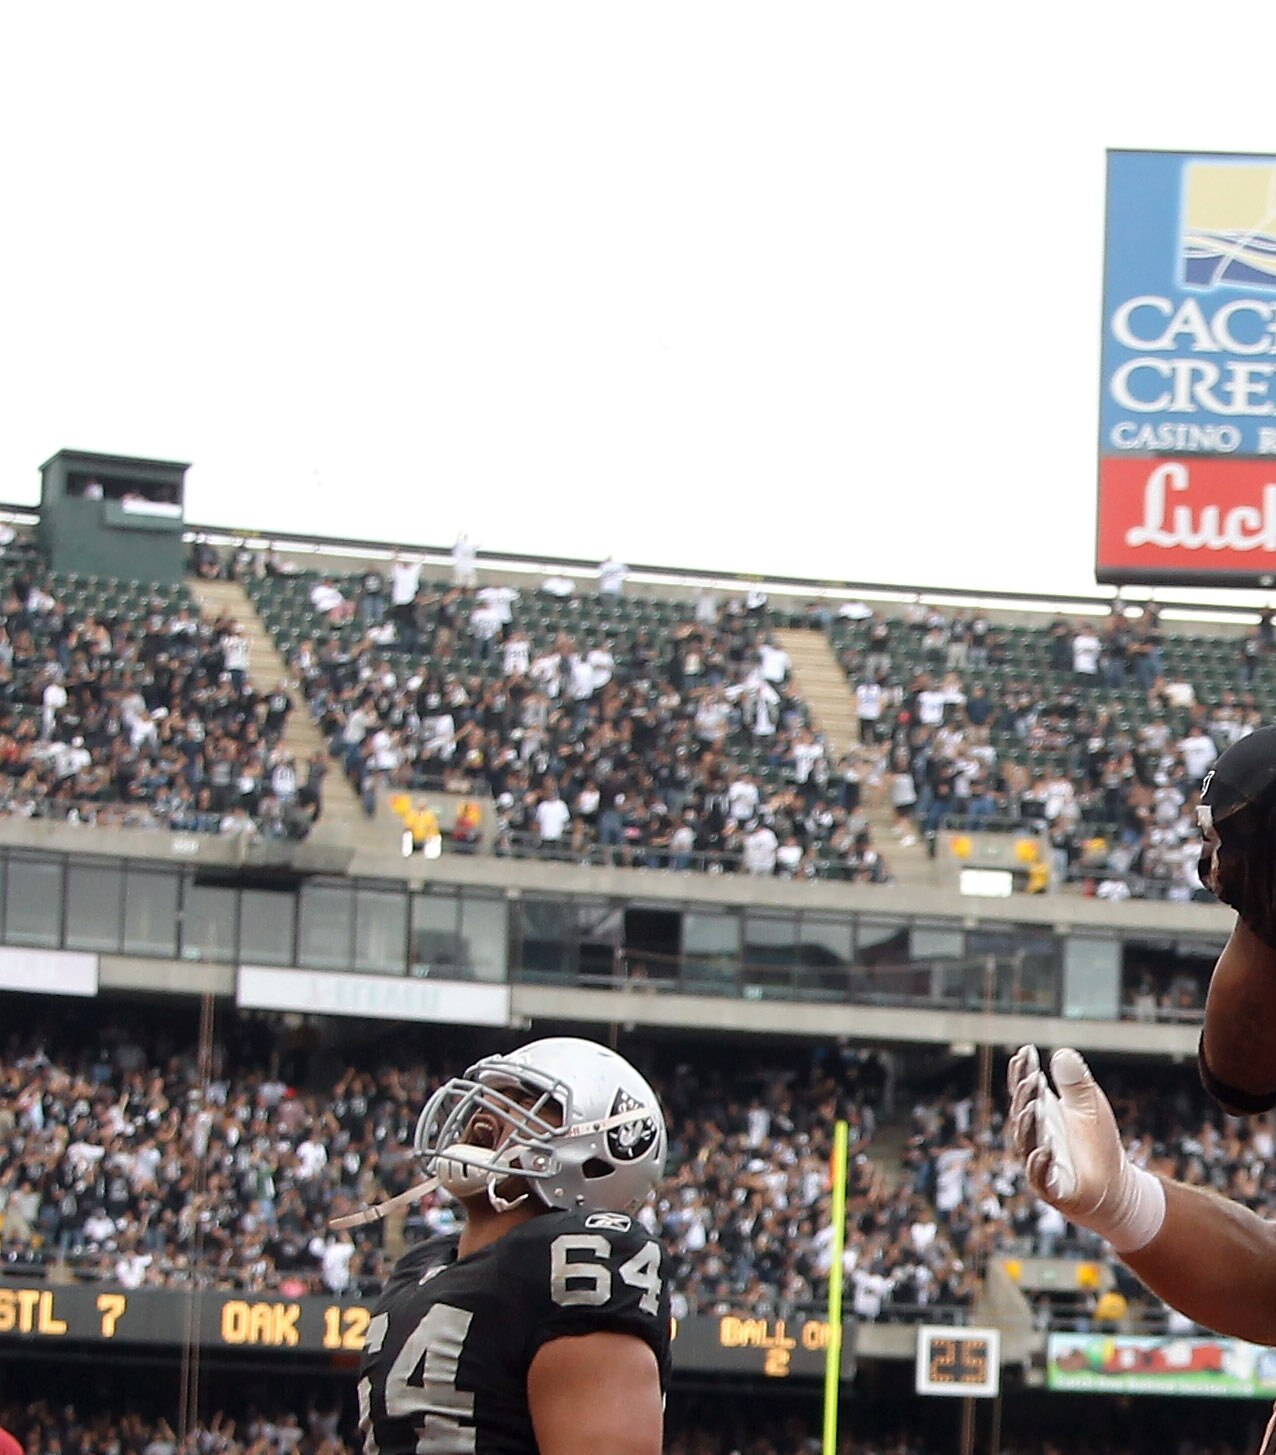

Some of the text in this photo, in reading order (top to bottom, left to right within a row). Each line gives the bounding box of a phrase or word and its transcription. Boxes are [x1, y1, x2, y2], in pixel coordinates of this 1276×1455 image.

[1110, 421, 1242, 454] CASINO
[550, 1234, 663, 1316] 64
[96, 1293, 127, 1338] 7
[221, 1300, 300, 1347] OAK
[323, 1305, 371, 1350] 12
[720, 1316, 796, 1349] BALL
[765, 1349, 791, 1378] 2
[930, 1338, 987, 1383] 25
